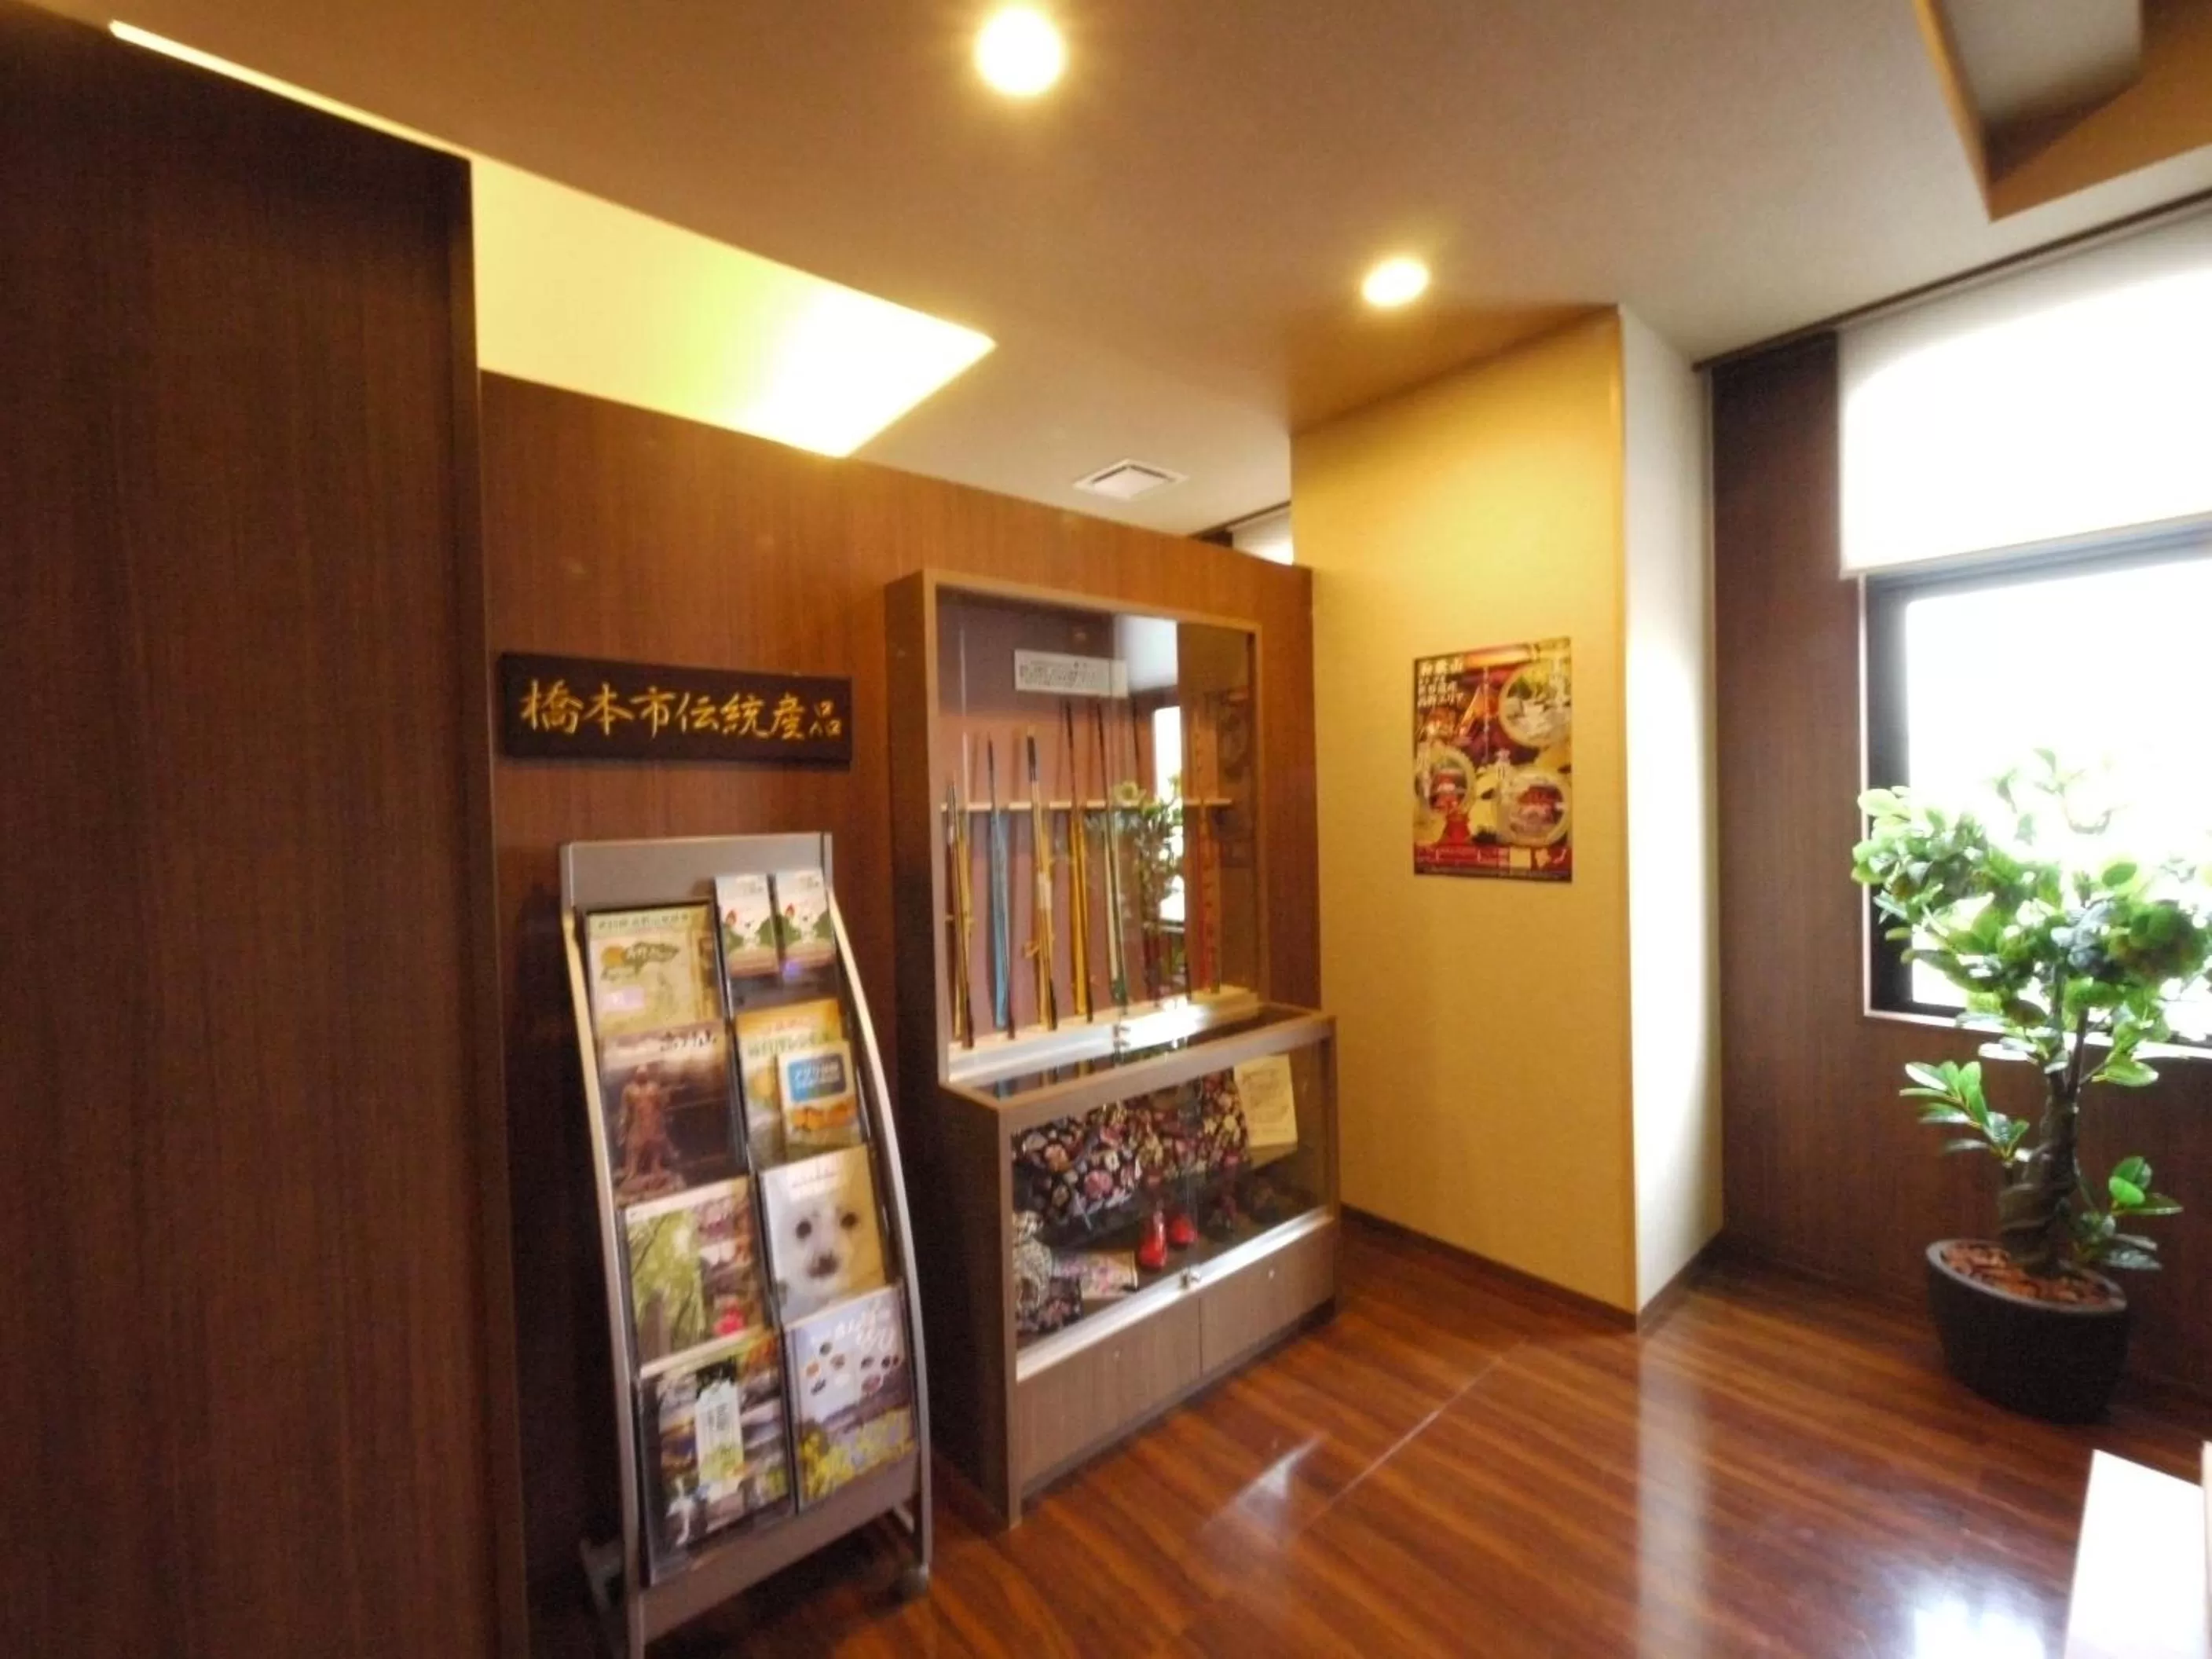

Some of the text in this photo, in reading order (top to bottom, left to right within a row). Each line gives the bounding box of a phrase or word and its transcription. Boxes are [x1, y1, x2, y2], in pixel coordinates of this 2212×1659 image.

[520, 679, 843, 740] 橋本市伝統産品
